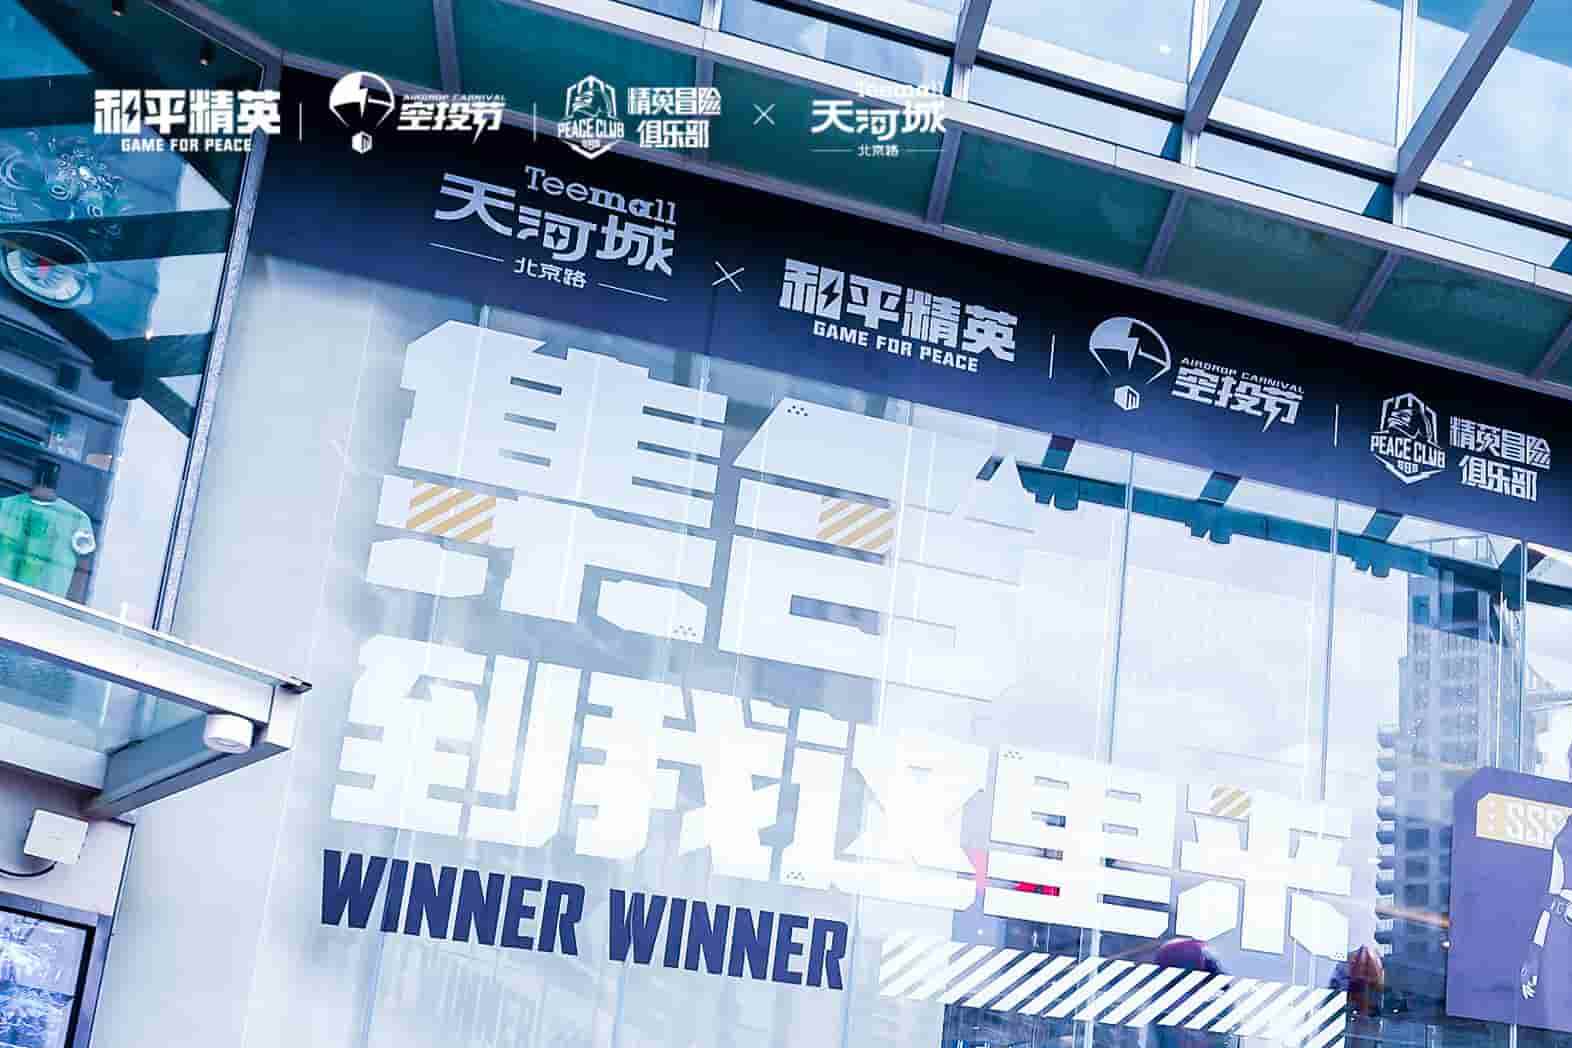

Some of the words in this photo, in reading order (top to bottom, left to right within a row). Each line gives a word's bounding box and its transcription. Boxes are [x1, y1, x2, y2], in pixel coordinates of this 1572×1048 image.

[524, 165, 677, 225] Teemall
[434, 172, 676, 277] 天河城
[513, 256, 588, 289] 北京路
[778, 257, 1019, 363] 和平精英
[813, 319, 869, 347] GAME
[876, 336, 913, 358] FOR
[919, 346, 979, 373] PEACE
[1171, 367, 1303, 432] 空投节
[1240, 372, 1304, 394] CARNIVAL
[1370, 435, 1412, 461] PEACE
[1413, 441, 1446, 469] CLUB
[1449, 414, 1551, 470] 精英冒险
[1457, 454, 1538, 502] 俱乐部
[329, 633, 1352, 959] 到我这里来
[320, 848, 587, 957] WINNER
[607, 887, 850, 991] WINNER
